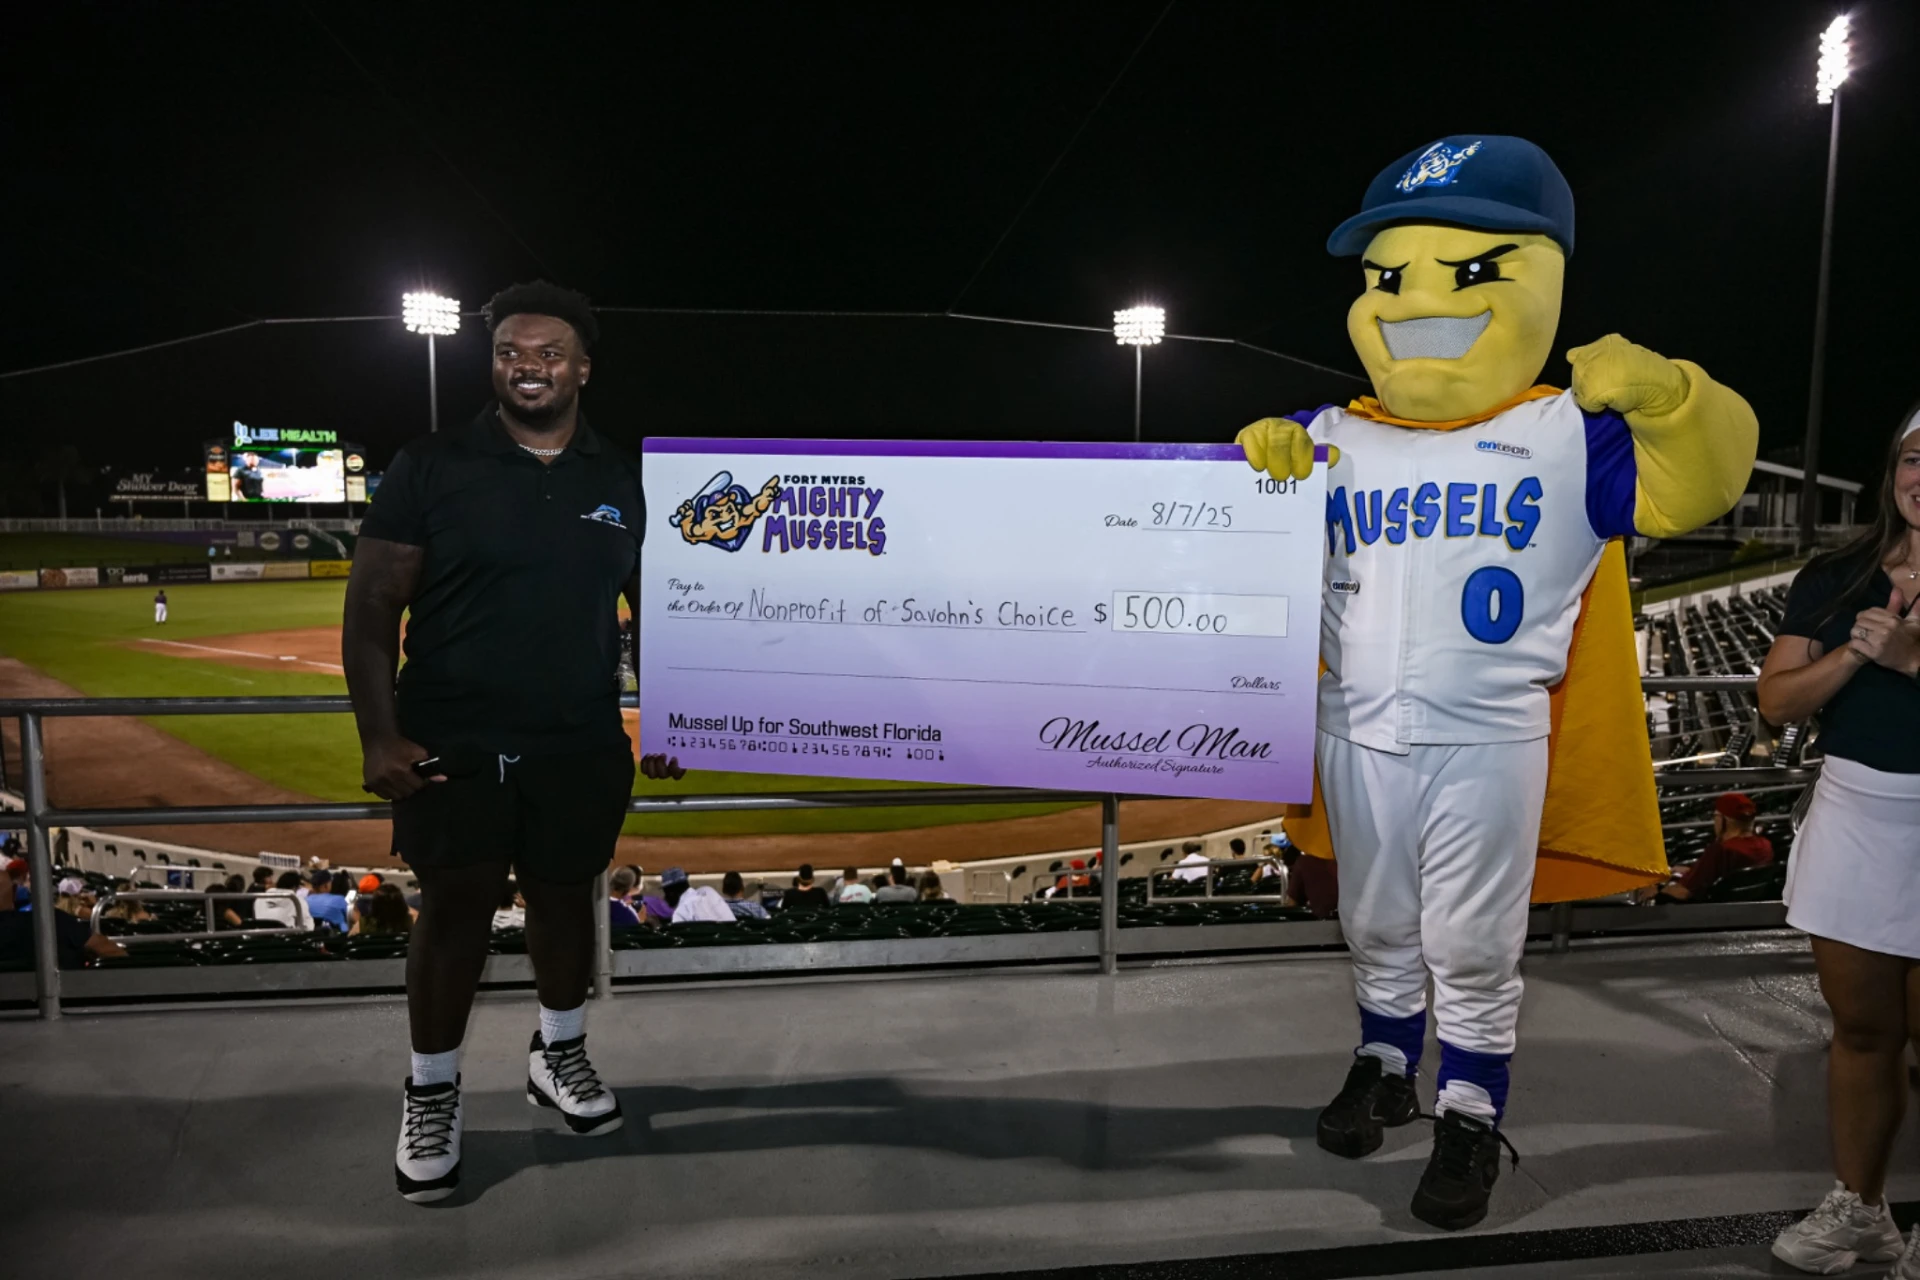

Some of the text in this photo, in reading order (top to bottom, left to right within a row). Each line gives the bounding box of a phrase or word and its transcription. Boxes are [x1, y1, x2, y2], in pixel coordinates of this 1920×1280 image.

[251, 428, 338, 443] LEE HEALTH
[784, 475, 866, 485] FORT MYERS
[1255, 478, 1298, 494] 1001
[772, 486, 884, 520] MIGHTY
[1151, 501, 1234, 528] 8/7/25
[1104, 514, 1138, 528] Date
[1327, 476, 1544, 557] MUSSELS
[762, 515, 886, 556] MUSSELS
[667, 578, 705, 592] Pay to
[667, 600, 744, 619] the Order Of
[749, 588, 1077, 627] Nonprofit of Savohn's Choice
[1094, 602, 1108, 625] $
[1123, 595, 1228, 633] 500.00
[1230, 675, 1282, 691] Dollars
[669, 712, 942, 742] Mussel Up for Southwest Florida
[1039, 716, 1272, 760] Mussel Man
[1085, 755, 1225, 778] Authorized Signature
